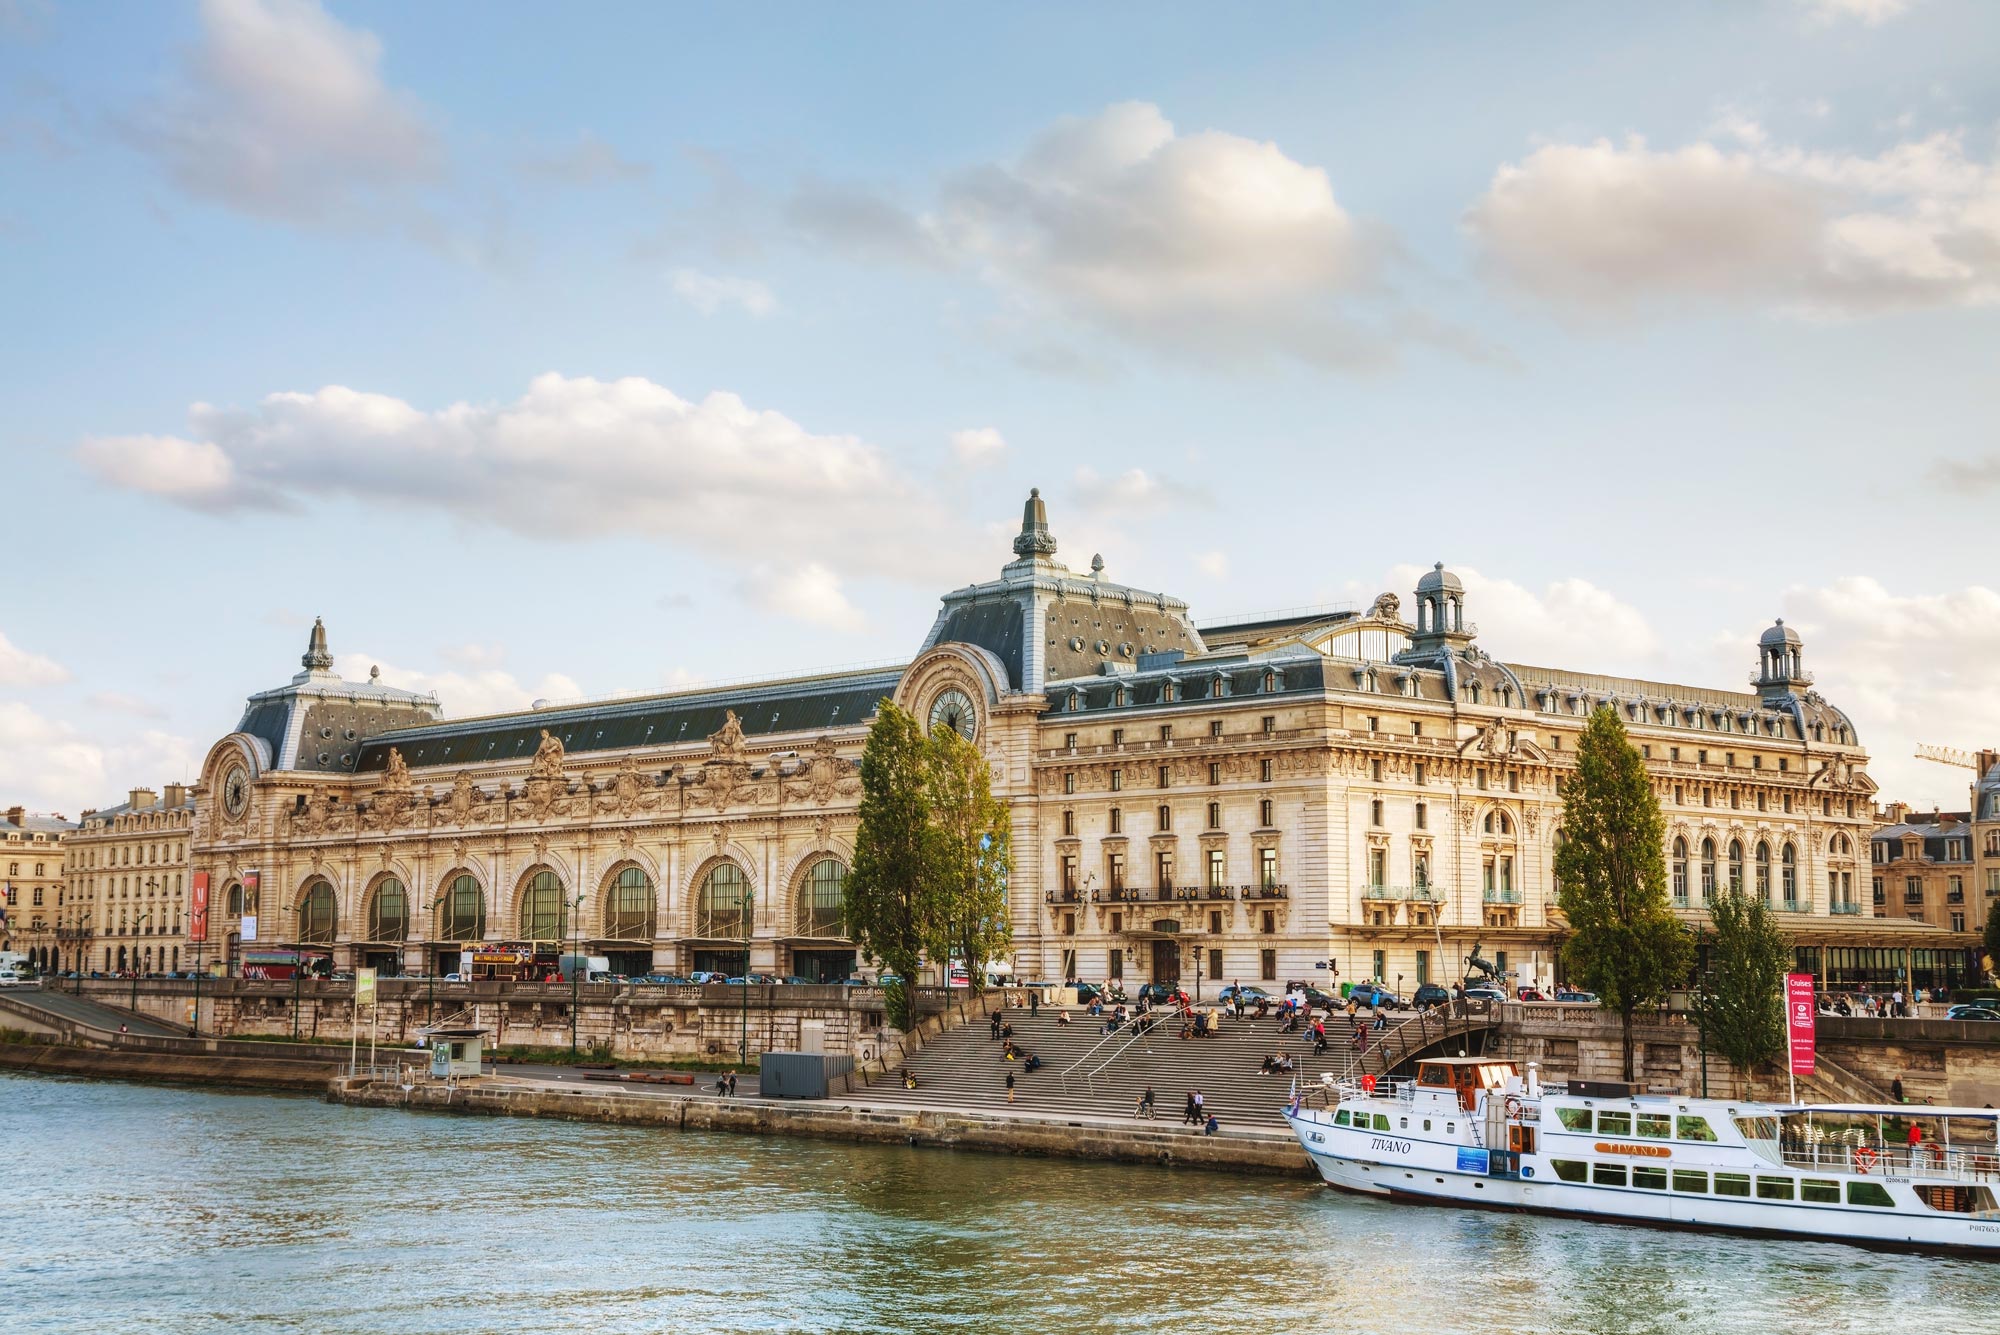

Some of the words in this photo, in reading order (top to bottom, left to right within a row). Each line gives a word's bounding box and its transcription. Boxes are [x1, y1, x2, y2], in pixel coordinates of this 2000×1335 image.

[1790, 979, 1811, 987] Cruises
[1371, 1138, 1411, 1154] TIVANO
[1607, 1143, 1658, 1156] TIVANO
